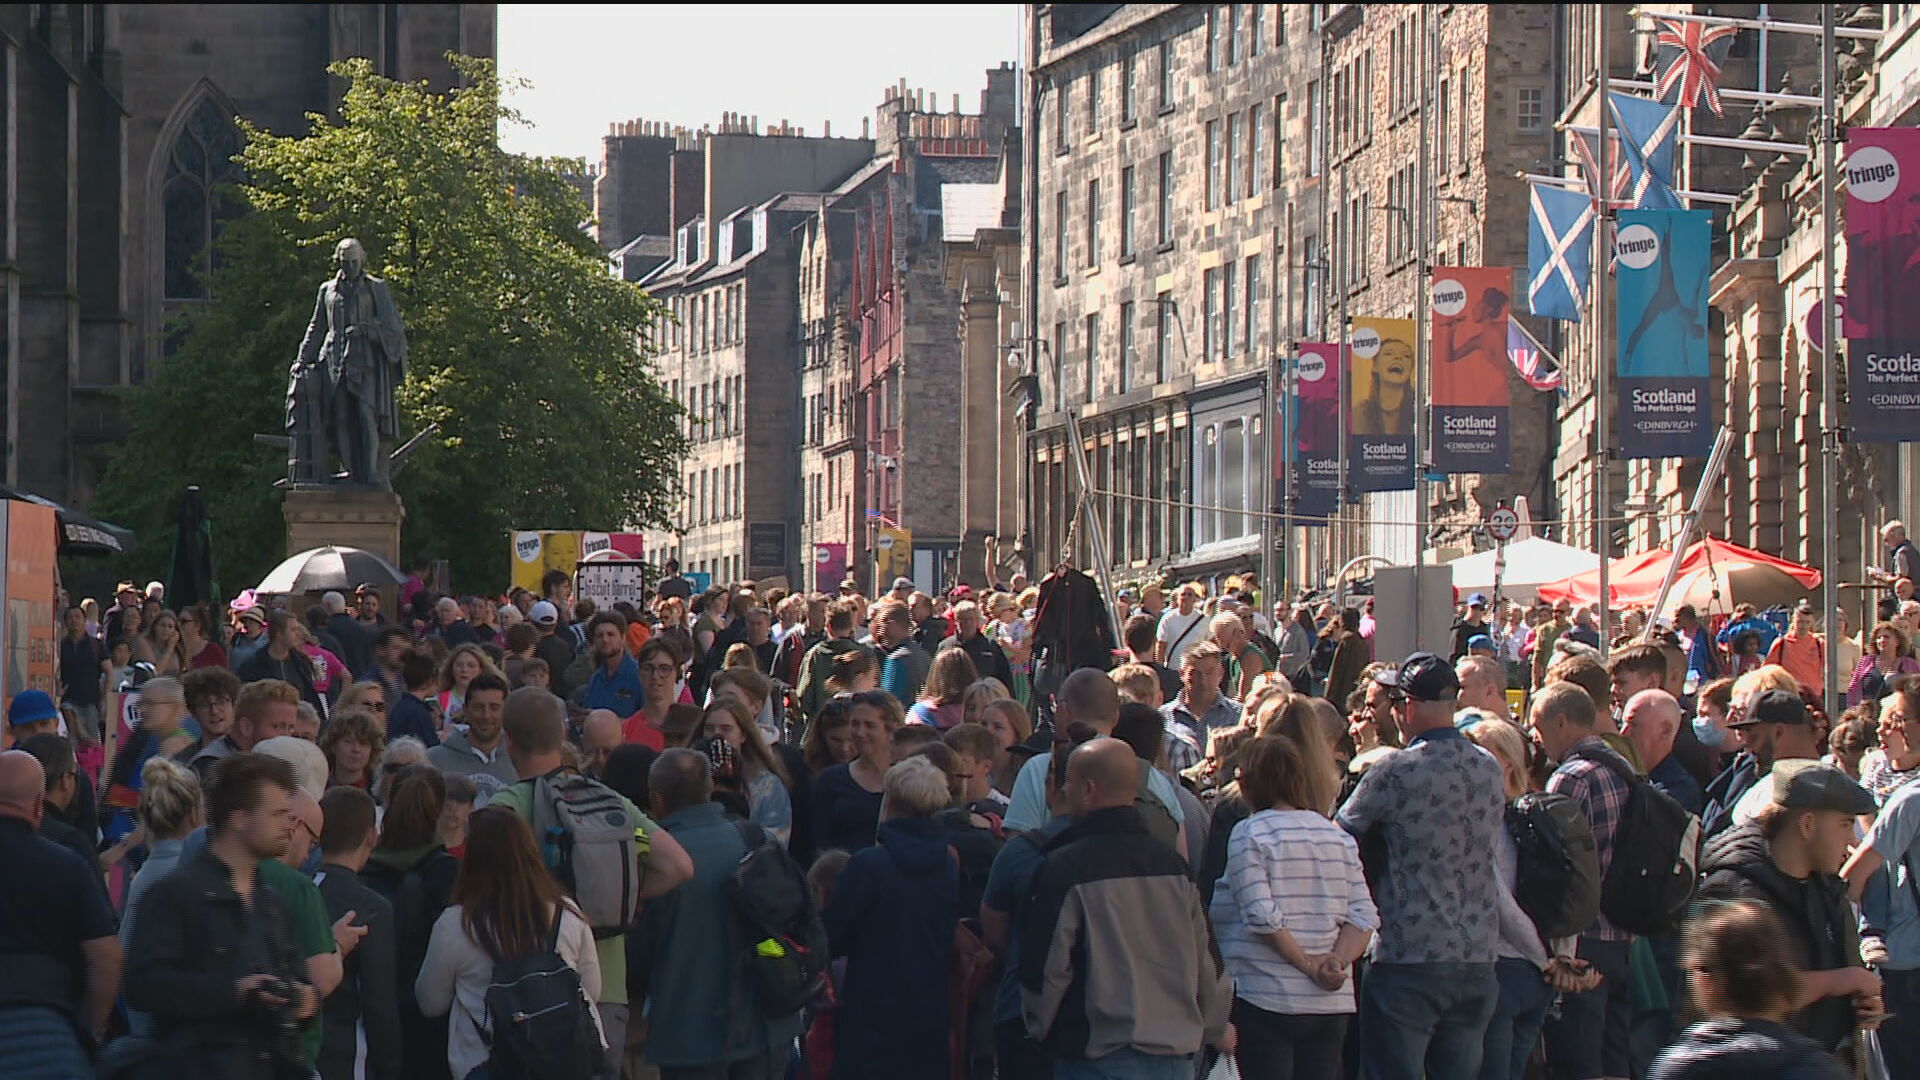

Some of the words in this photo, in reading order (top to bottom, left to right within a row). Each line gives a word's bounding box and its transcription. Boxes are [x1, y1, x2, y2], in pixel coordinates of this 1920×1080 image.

[1848, 163, 1895, 185] fringe
[1618, 238, 1656, 255] fringe
[1433, 290, 1465, 304] fringe
[1353, 337, 1379, 349] fringe
[1299, 361, 1324, 373] fringe
[1867, 373, 1885, 383] The
[1886, 373, 1918, 383] Perfect
[1632, 387, 1697, 405] Scotland
[1633, 404, 1647, 413] The
[1648, 404, 1674, 413] Perfect
[1675, 404, 1697, 414] Stage
[1443, 415, 1497, 429] Scotland
[1362, 443, 1407, 455] Scotland
[517, 538, 539, 552] fringe
[585, 538, 609, 552] fringe
[585, 579, 610, 597] biscuit
[612, 579, 636, 597] barrel
